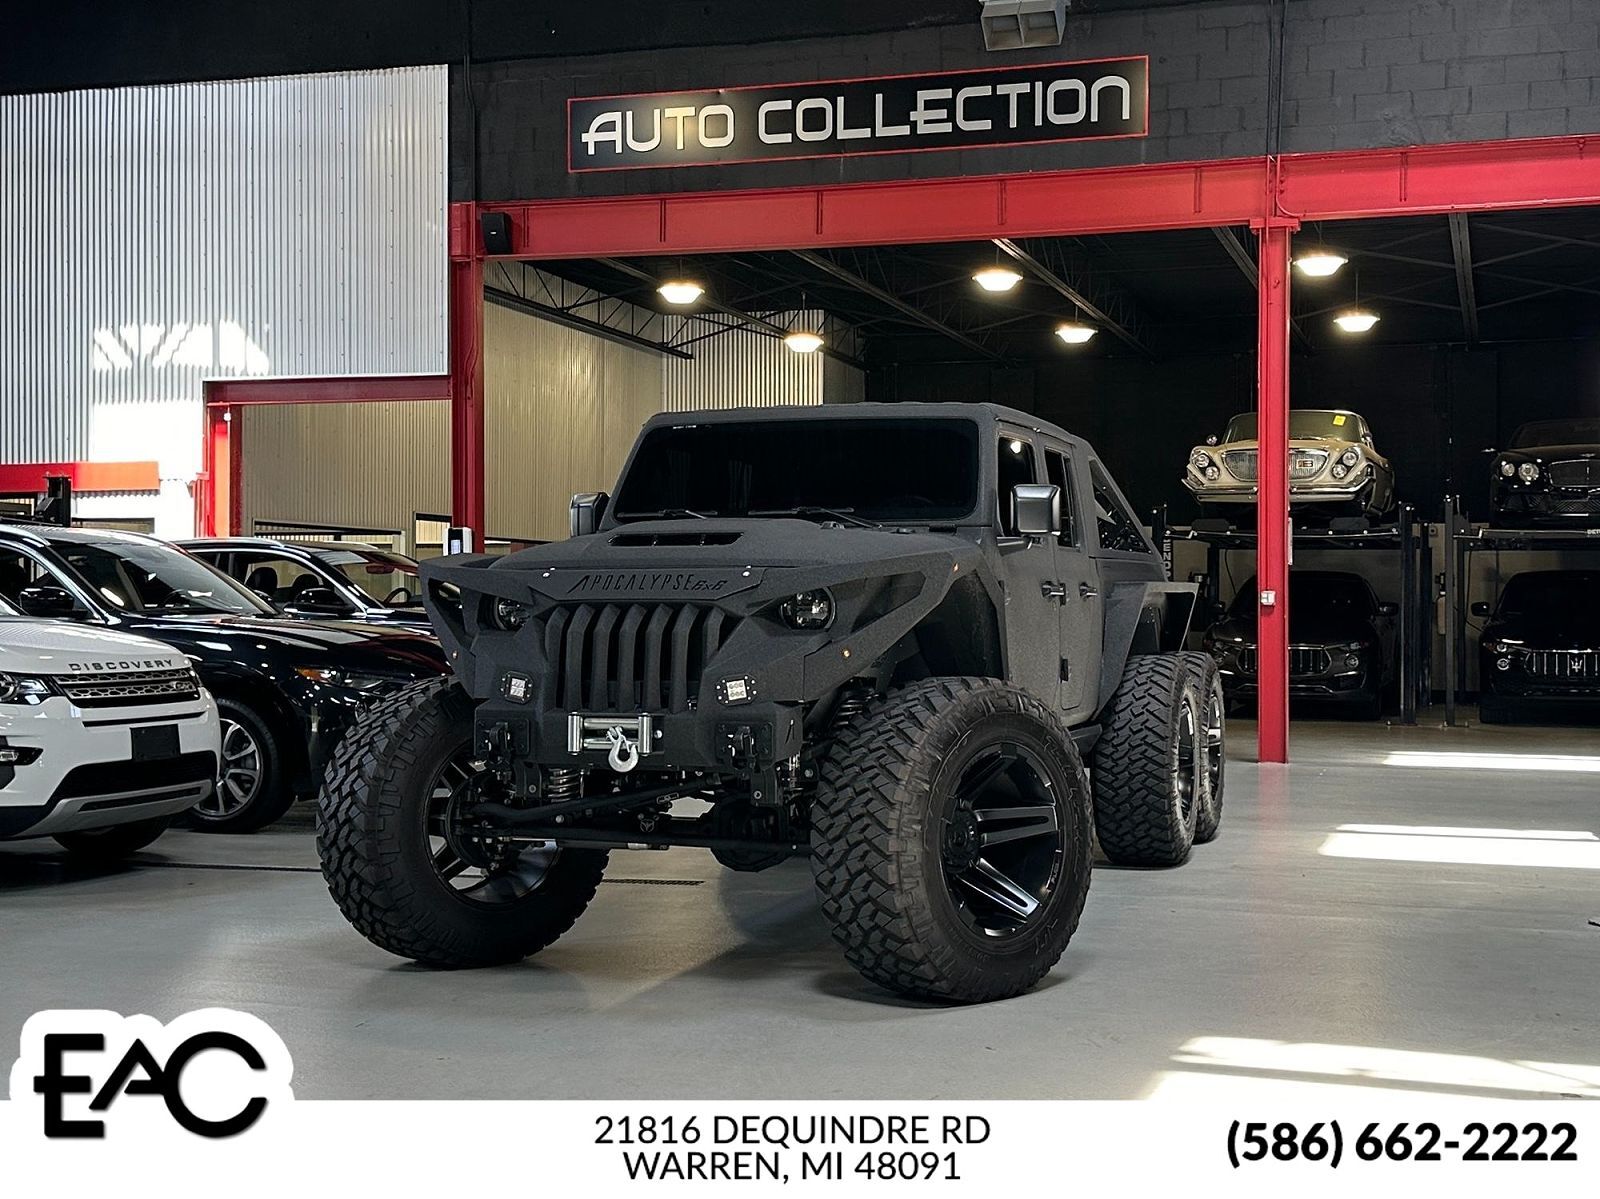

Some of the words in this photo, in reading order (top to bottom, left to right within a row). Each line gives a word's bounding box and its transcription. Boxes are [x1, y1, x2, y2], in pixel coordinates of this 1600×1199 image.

[581, 104, 735, 155] AUTO
[758, 75, 1131, 144] COLLECTION
[69, 659, 173, 671] DISCOVERY
